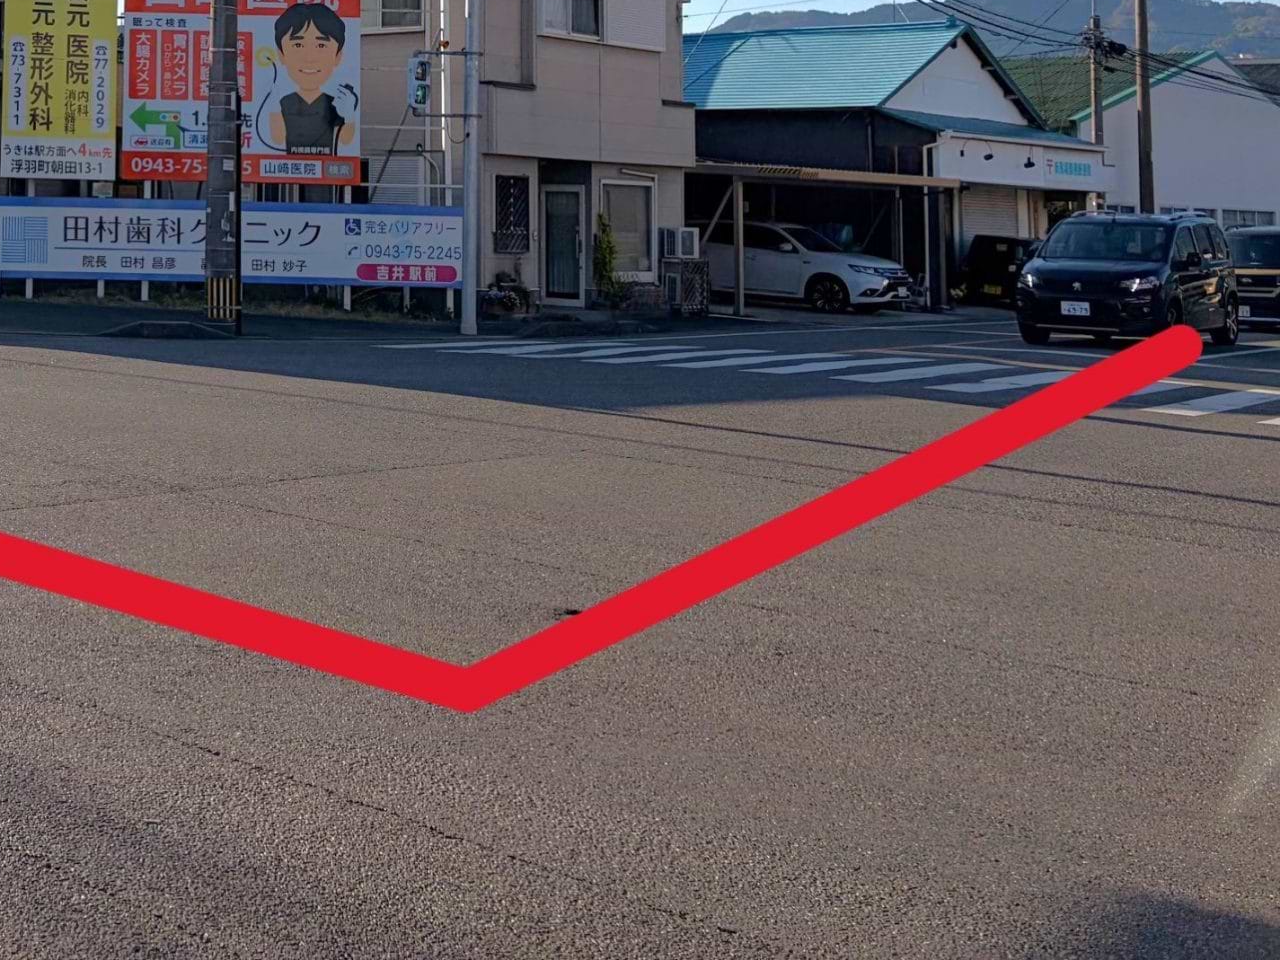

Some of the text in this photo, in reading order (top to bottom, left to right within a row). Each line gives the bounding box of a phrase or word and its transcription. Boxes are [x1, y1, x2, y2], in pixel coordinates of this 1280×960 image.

[135, 32, 151, 96] 大腸カメラ
[11, 54, 25, 126] 73-7311
[94, 58, 108, 129] 77-2029
[77, 90, 89, 117] 内科
[10, 159, 103, 175] 浮羽町朝田13-1
[63, 215, 321, 247] 田村歯科クニック
[364, 221, 457, 234] 完全バリアフリー
[365, 244, 462, 261] 0943-75-2245
[82, 255, 107, 268] 院長
[120, 256, 145, 269] 田村
[252, 259, 308, 272] 田村 妙子
[376, 266, 437, 281] 吉井駅前
